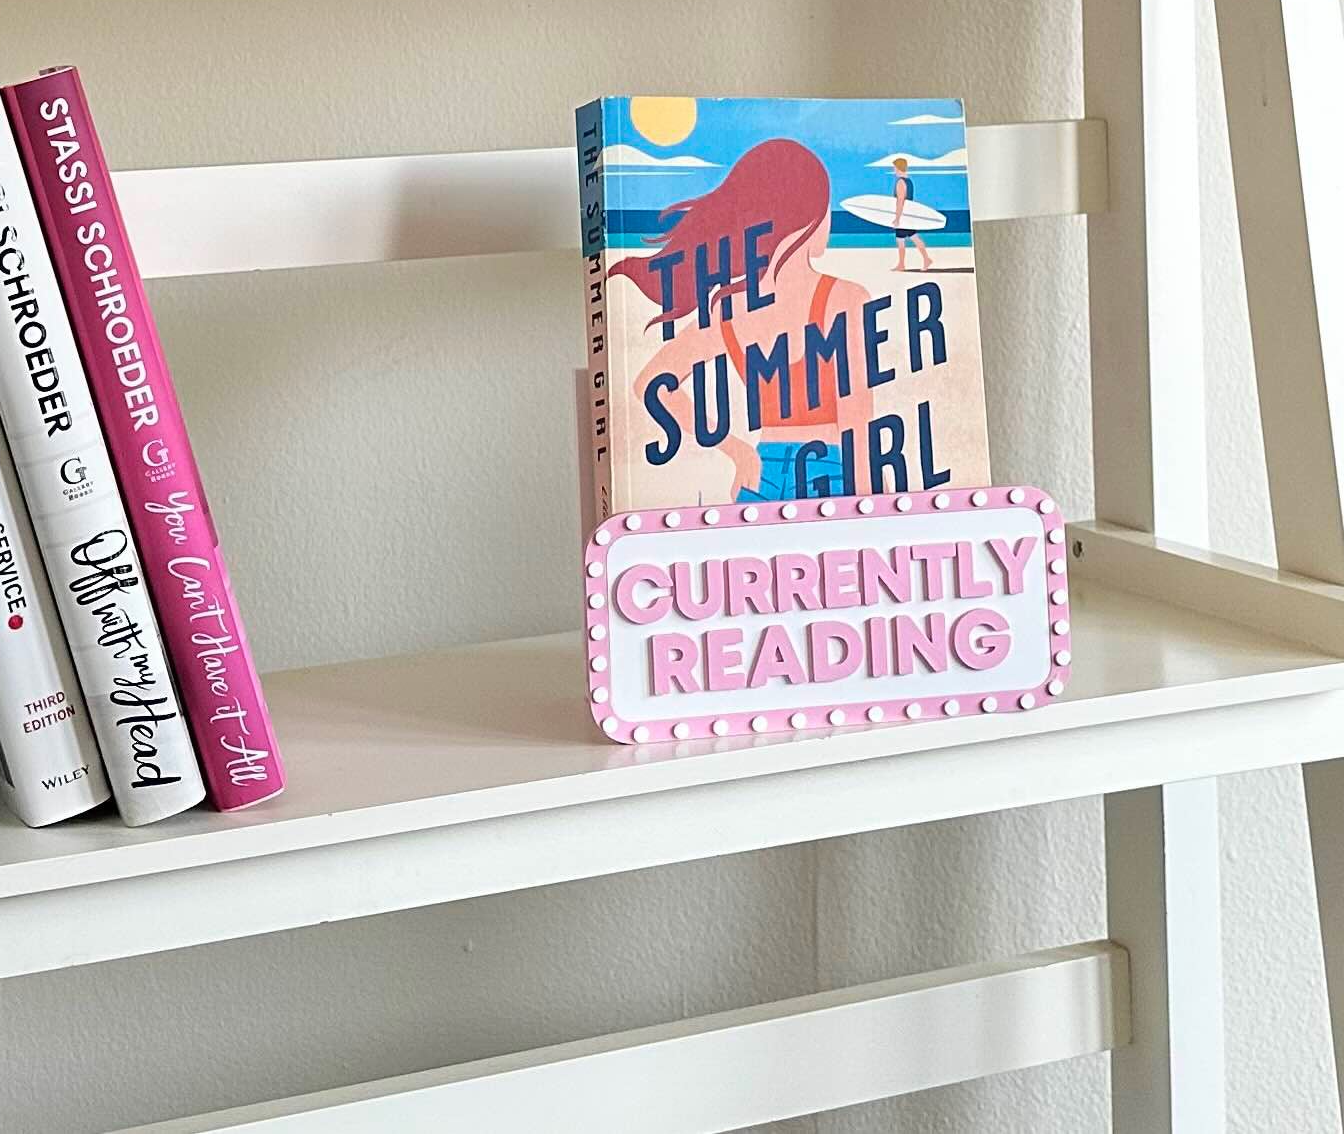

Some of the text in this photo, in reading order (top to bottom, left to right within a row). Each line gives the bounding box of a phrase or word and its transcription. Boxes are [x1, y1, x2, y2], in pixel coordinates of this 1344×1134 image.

[582, 122, 599, 188] THE
[40, 97, 159, 431] STASSI SCHROEDER
[586, 199, 605, 355] SUMMER
[649, 221, 776, 342] THE
[593, 371, 608, 463] GIRL
[644, 282, 947, 466] SUMMER
[794, 401, 951, 499] GIRL
[613, 537, 1038, 625] CURRENTLY
[69, 529, 182, 789] Off with my Head
[144, 491, 268, 786] You Can't Have it All
[647, 608, 1012, 697] READING
[23, 705, 76, 733] EDITION
[24, 692, 65, 715] THIRD
[41, 765, 90, 791] WILEY
